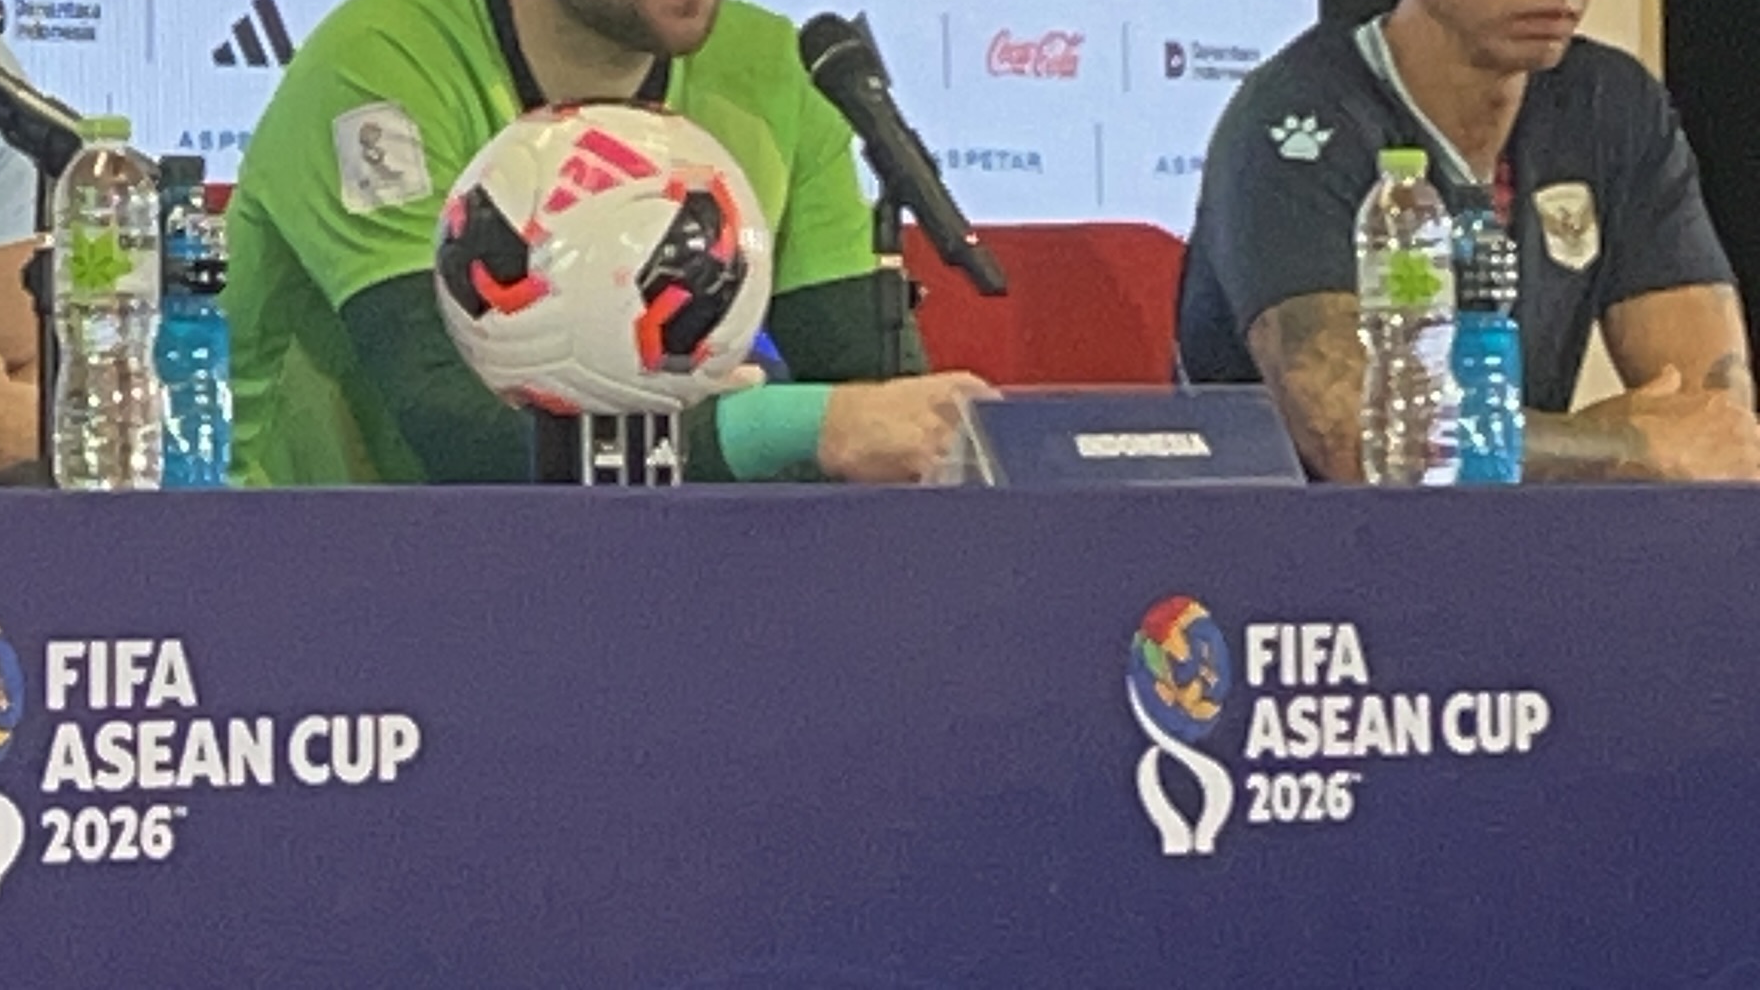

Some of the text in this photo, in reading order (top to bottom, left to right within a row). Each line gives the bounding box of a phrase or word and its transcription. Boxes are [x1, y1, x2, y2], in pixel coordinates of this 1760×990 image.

[937, 150, 1040, 175] SPETAR
[46, 639, 198, 709] FIFA
[1246, 623, 1368, 686] FIFA
[42, 714, 421, 792] ASEAN CUP
[1244, 690, 1550, 759] ASEAN CUP
